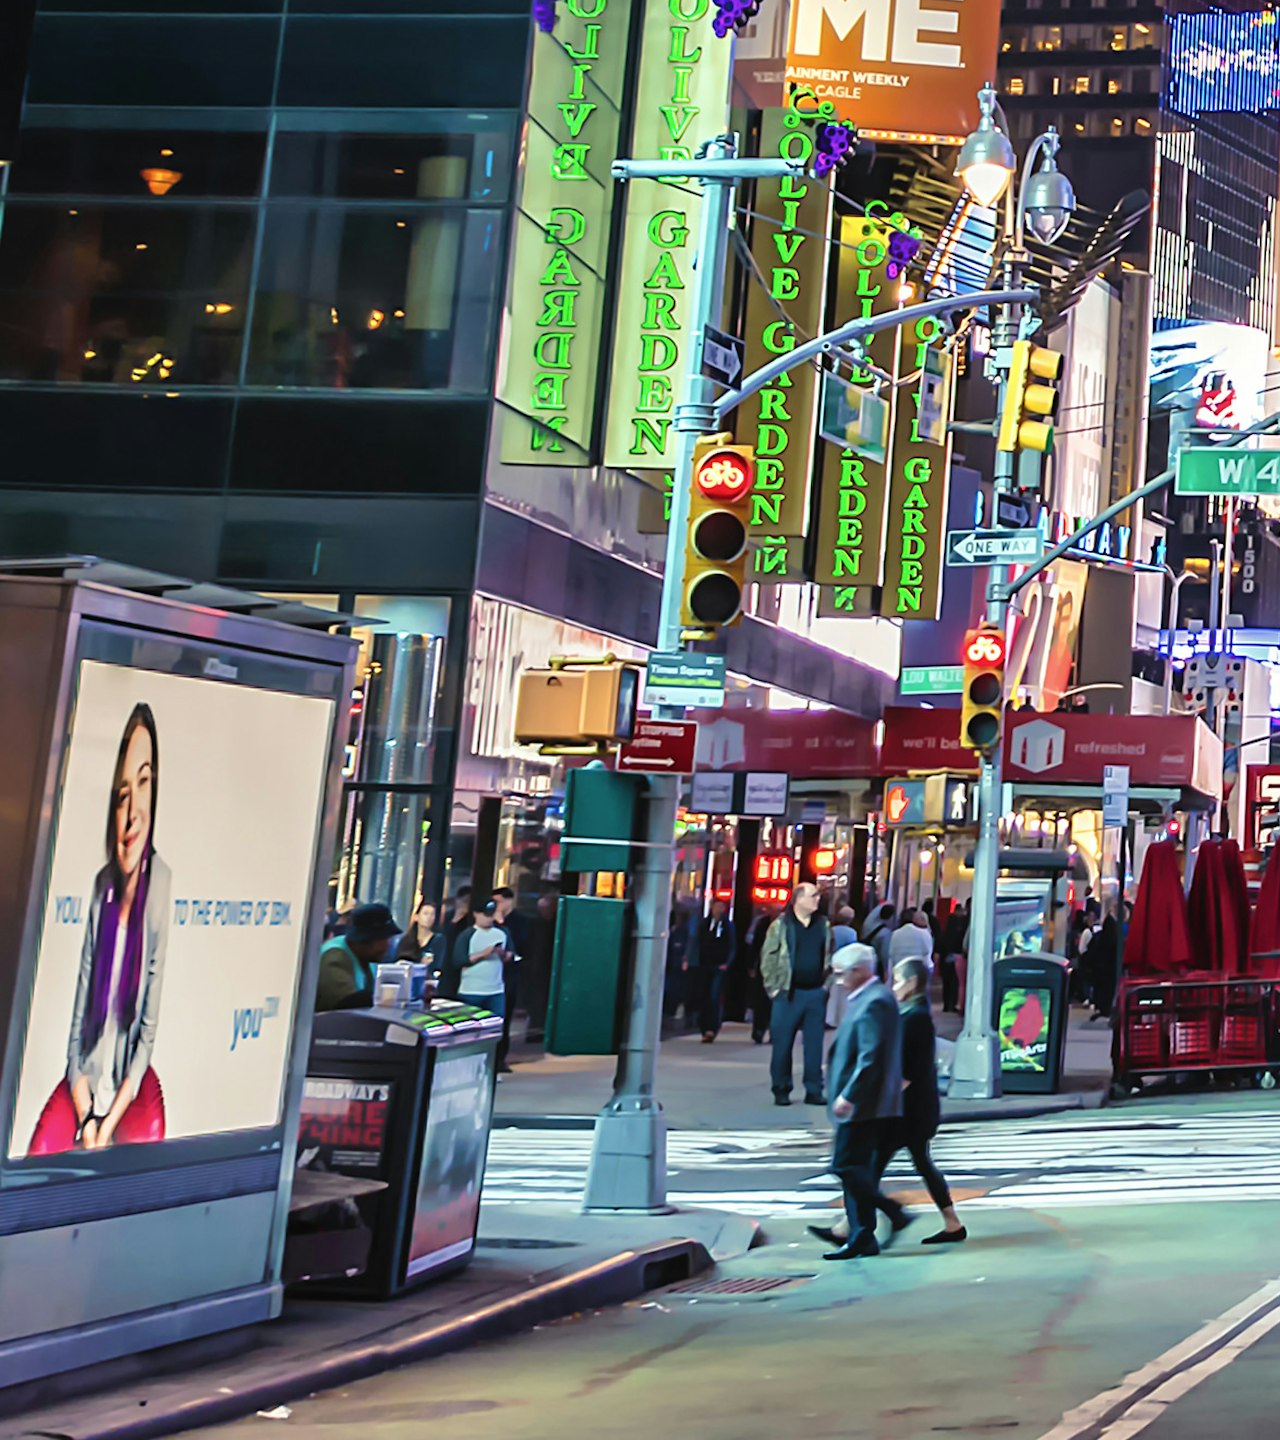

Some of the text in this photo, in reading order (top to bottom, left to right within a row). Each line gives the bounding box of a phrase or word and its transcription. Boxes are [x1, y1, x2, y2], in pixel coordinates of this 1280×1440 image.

[852, 70, 910, 88] WEEKLY
[815, 84, 862, 100] CAGLE
[849, 236, 886, 385] OLIE
[628, 210, 690, 457] GARDEN
[1218, 458, 1245, 485] W
[831, 444, 869, 576] RDEN
[898, 457, 931, 613] GARDEN
[964, 539, 1030, 554] ONE WAY
[1243, 535, 1256, 594] 1500
[650, 664, 714, 677] Times Square
[903, 737, 936, 750] we'll
[1073, 740, 1147, 757] refreshed
